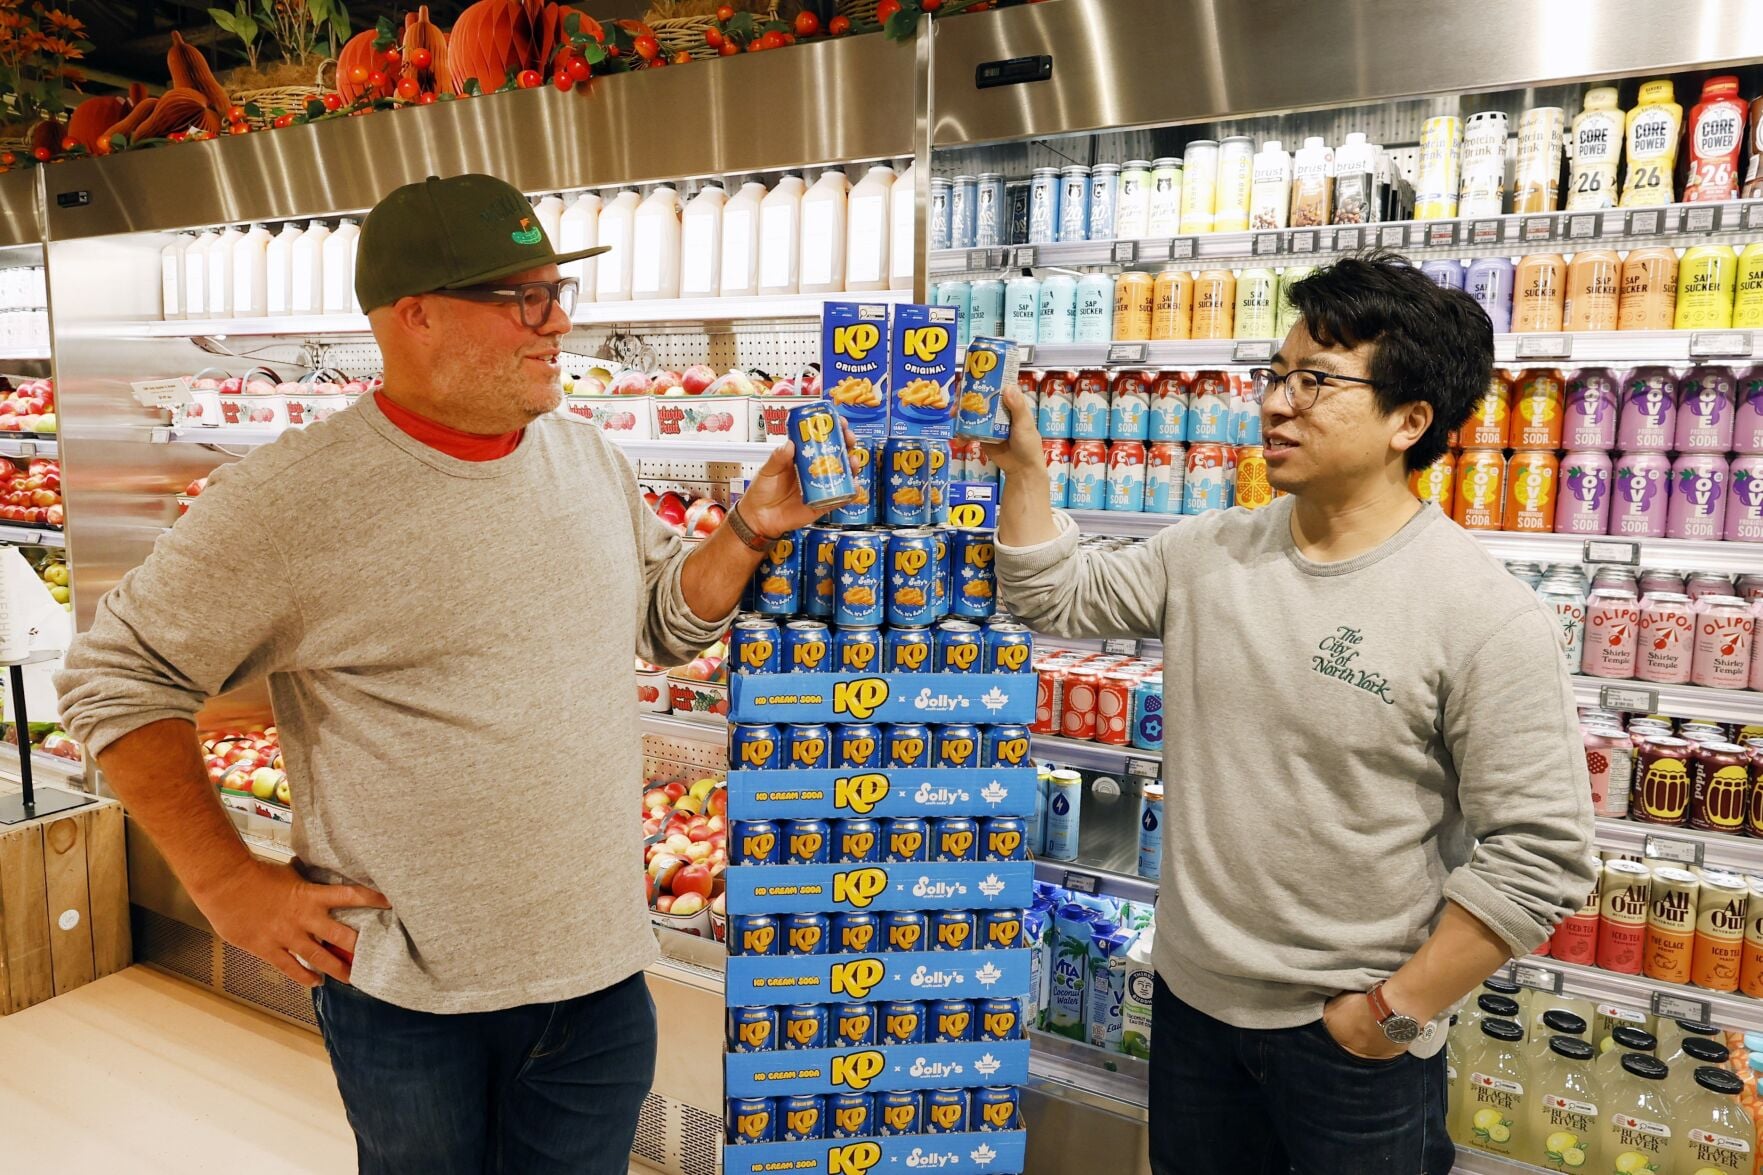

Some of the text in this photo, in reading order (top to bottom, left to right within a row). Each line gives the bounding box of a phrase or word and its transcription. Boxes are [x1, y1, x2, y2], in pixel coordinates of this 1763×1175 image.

[1580, 128, 1608, 144] CORE
[1635, 122, 1667, 138] CORE
[1702, 118, 1735, 138] CORE
[1580, 144, 1606, 156] POWER
[1635, 138, 1666, 152] POWER
[1702, 137, 1734, 150] POWER
[1578, 172, 1600, 192] 26
[1634, 168, 1660, 190] 26
[1702, 165, 1728, 186] 26
[1596, 276, 1612, 284] SAP
[1626, 276, 1640, 284] SAP
[1694, 274, 1712, 282] SAP
[1586, 286, 1616, 294] SUCKER
[1684, 283, 1720, 293] SUCKER
[1080, 307, 1103, 316] SUCKER
[1084, 300, 1098, 308] SAP
[833, 322, 880, 360] KD
[904, 326, 950, 363] KD
[835, 362, 878, 374] ORIGINAL
[904, 363, 946, 376] ORIGINAL
[964, 350, 998, 379] KD
[1584, 377, 1600, 428] COVE
[1647, 376, 1663, 428] COVE
[1699, 376, 1716, 428] COVE
[799, 412, 834, 443] KD
[1046, 423, 1065, 432] SODA
[1118, 424, 1138, 432] SODA
[1160, 425, 1180, 434] SODA
[1196, 425, 1216, 434] SODA
[1475, 433, 1500, 444] SODA
[1522, 434, 1549, 444] SODA
[1575, 434, 1601, 444] SODA
[1636, 435, 1664, 446] SODA
[1690, 436, 1718, 447] SODA
[893, 449, 925, 476] KD
[1474, 459, 1488, 508] COVE
[1526, 461, 1542, 511] COVE
[1582, 463, 1598, 514] COVE
[1630, 464, 1646, 514] COVE
[1696, 466, 1712, 518] COVE
[1110, 495, 1128, 504] SODA
[948, 504, 986, 528] KD
[1465, 515, 1490, 526] SODA
[1518, 518, 1544, 528] SODA
[1572, 520, 1599, 530] SODA
[1621, 521, 1648, 532] SODA
[1685, 524, 1713, 536] SODA
[844, 547, 876, 575] KD
[894, 549, 928, 576] KD
[965, 544, 995, 569] KD
[1641, 612, 1692, 632] OLIPOP
[1337, 626, 1364, 644] The
[740, 640, 773, 668] KD
[793, 641, 826, 668] KD
[843, 642, 875, 669] KD
[896, 642, 928, 669] KD
[947, 643, 979, 670] KD
[1318, 636, 1352, 658] City
[1602, 649, 1630, 658] Shirley
[1648, 652, 1678, 661] Shirley
[997, 644, 1029, 671] KD
[1335, 652, 1360, 668] of
[1602, 656, 1630, 664] Temple
[1648, 660, 1678, 668] Temple
[1714, 658, 1744, 668] Shirley
[1312, 656, 1394, 704] North York
[1714, 666, 1744, 675] Temple
[833, 678, 889, 720] KD
[914, 688, 970, 711] Solly's
[741, 739, 774, 766] KD
[843, 737, 875, 764] KD
[941, 738, 973, 764] KD
[998, 738, 1029, 764] KD
[1694, 761, 1706, 800] poppi
[834, 773, 890, 814] KD
[914, 782, 970, 805] Solly's
[743, 832, 775, 860] KD
[790, 833, 823, 859] KD
[842, 832, 875, 859] KD
[890, 831, 922, 858] KD
[941, 831, 973, 857] KD
[989, 831, 1021, 857] KD
[832, 867, 888, 908] KD
[912, 876, 967, 898] Solly's
[1623, 884, 1646, 903] All
[1612, 896, 1645, 914] Our
[1660, 890, 1690, 910] All
[1724, 899, 1746, 917] All
[1653, 900, 1688, 922] Our
[1711, 910, 1744, 930] Our
[1566, 922, 1582, 932] ICED
[1612, 932, 1640, 942] ICED TEA
[1712, 947, 1728, 956] ICED
[1056, 958, 1080, 978] VITA
[830, 958, 964, 998] KD Solly's
[830, 1050, 964, 1090] KD Solly's
[1477, 1094, 1513, 1110] RIVER
[1478, 1086, 1513, 1102] BLACK
[1551, 1116, 1588, 1132] RIVER
[1552, 1108, 1588, 1124] BLACK
[1620, 1136, 1660, 1154] RIVER
[1622, 1128, 1659, 1144] BLACK
[828, 1141, 959, 1175] KD Solly's
[1697, 1151, 1738, 1169] RIVER
[1698, 1144, 1739, 1160] BLACK
